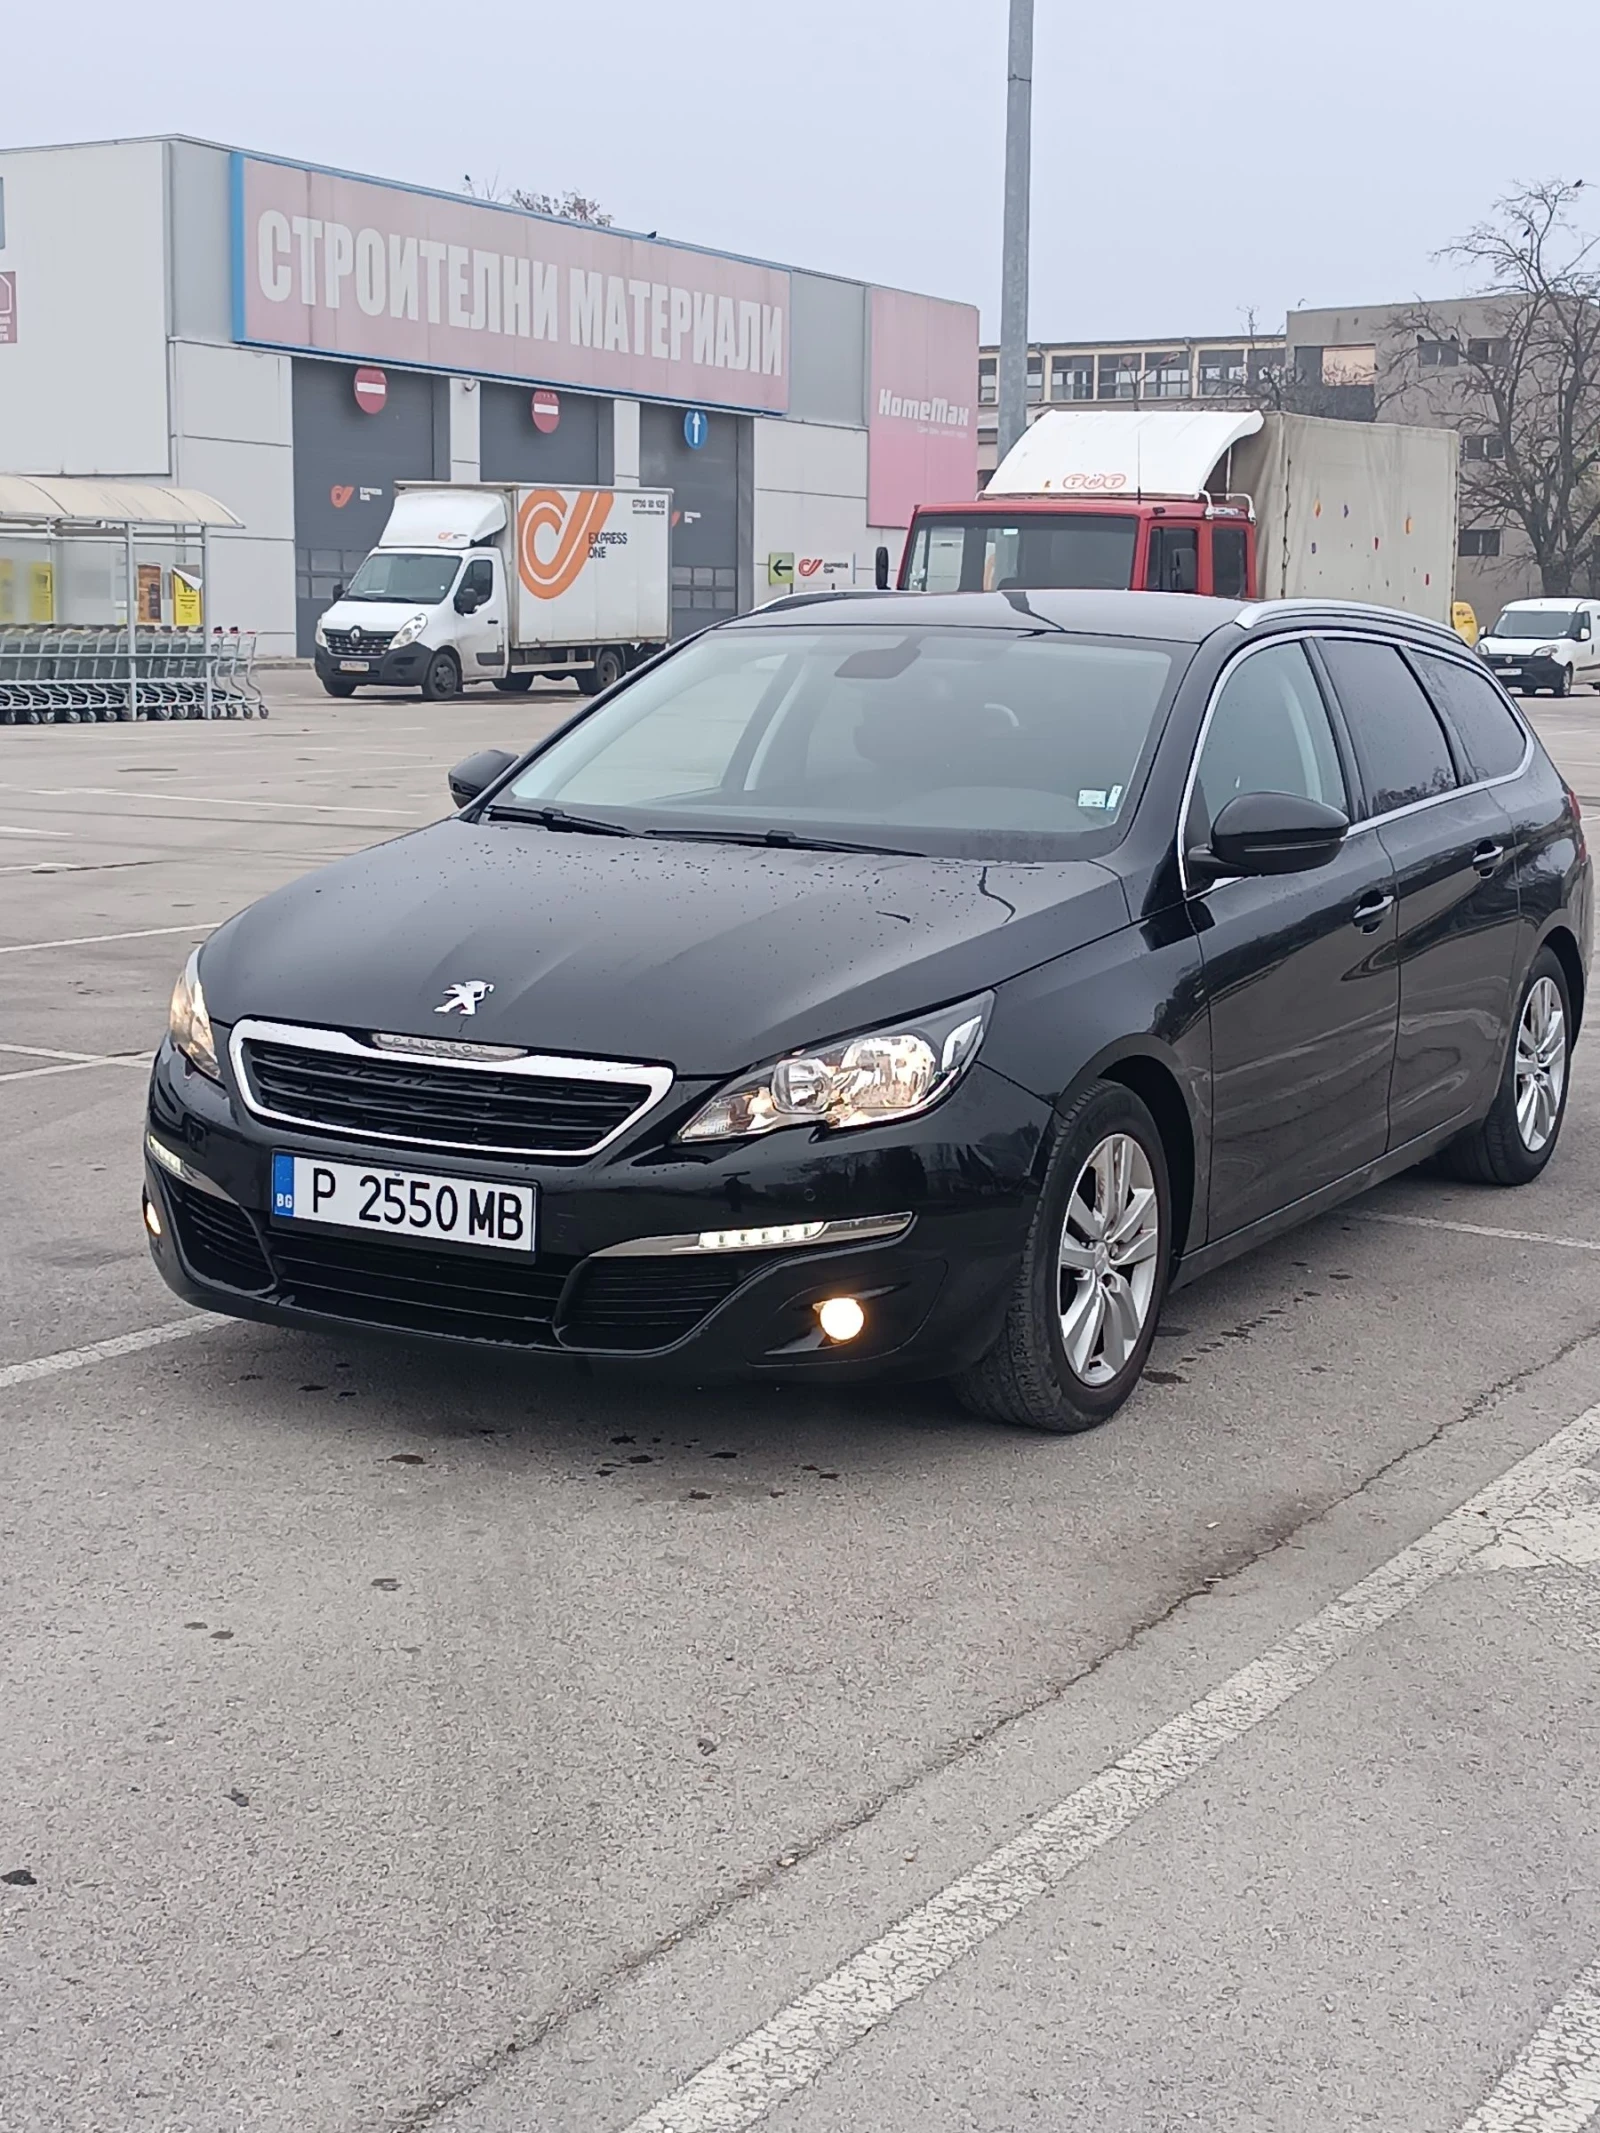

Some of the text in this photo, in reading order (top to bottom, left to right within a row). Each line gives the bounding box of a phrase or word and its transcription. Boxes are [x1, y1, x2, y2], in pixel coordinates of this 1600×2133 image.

[257, 209, 783, 376] СТРОИТЕЛНИ МАТЕРИАЛИ
[878, 388, 969, 426] HomeMax
[1067, 475, 1123, 488] TNT
[588, 532, 627, 544] EXPRESS
[587, 546, 606, 558] ONE
[393, 1036, 486, 1055] PEUGEOT
[276, 1192, 293, 1209] BG
[313, 1167, 523, 1241] P 2550 MB
